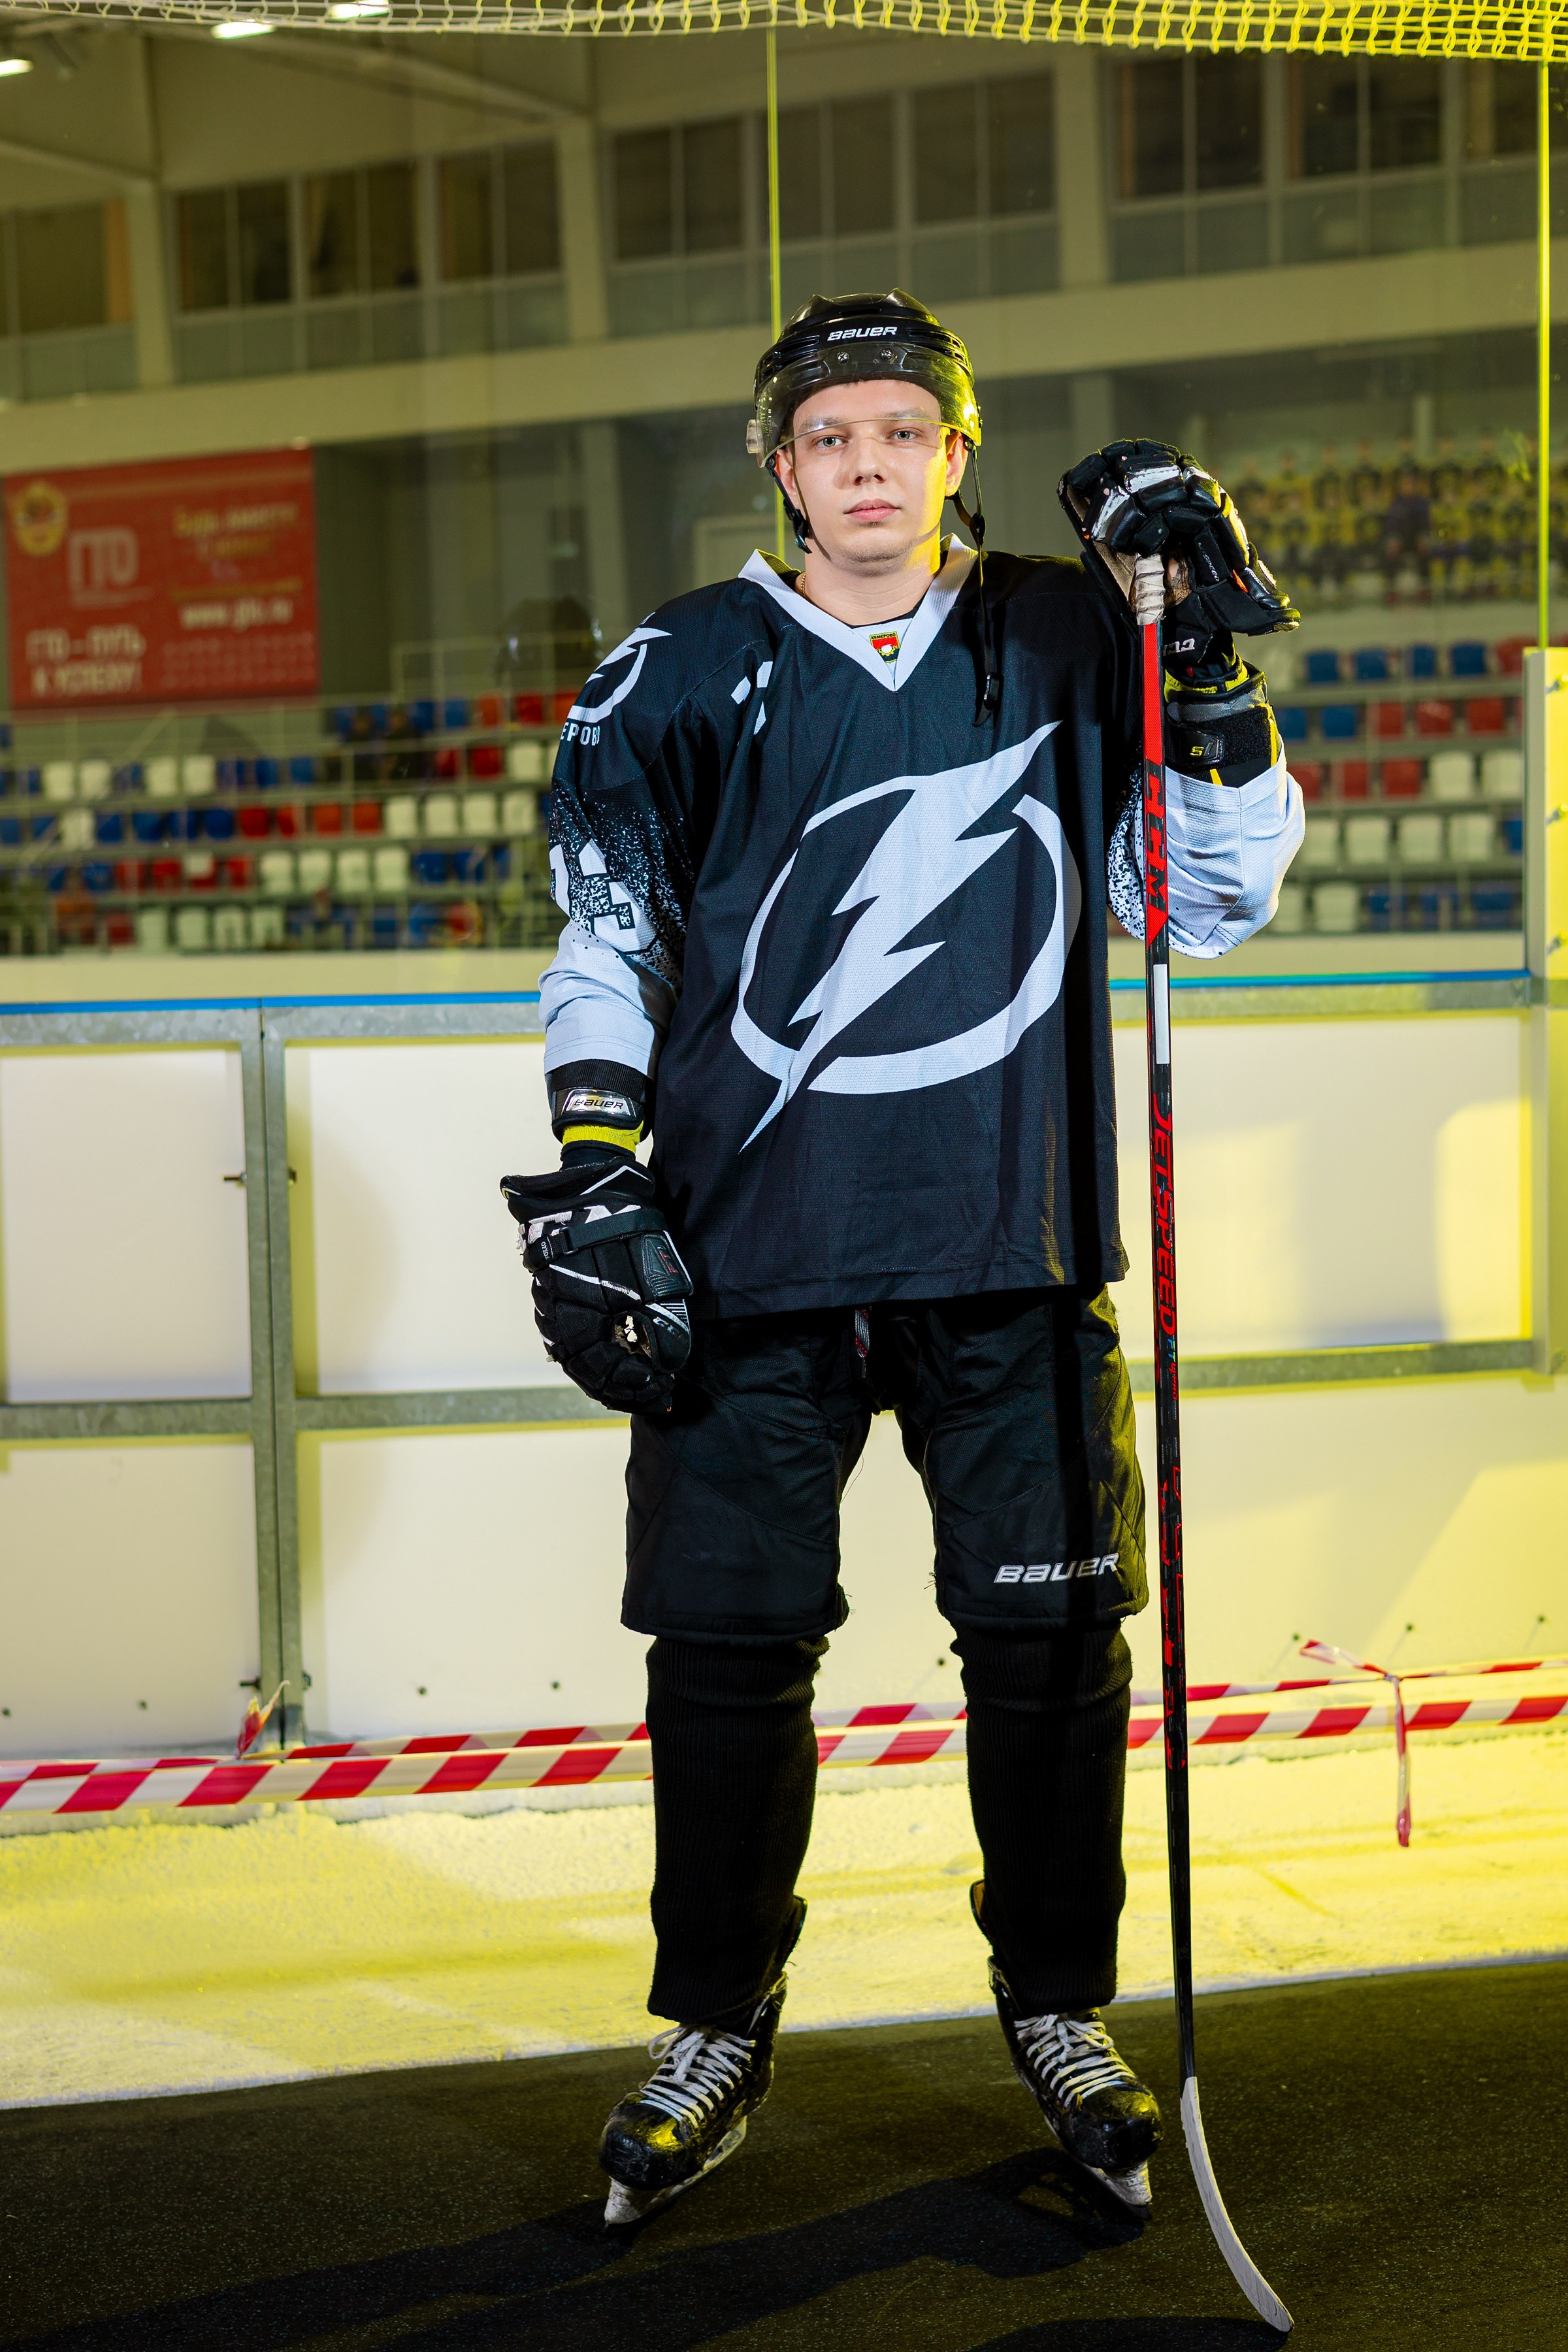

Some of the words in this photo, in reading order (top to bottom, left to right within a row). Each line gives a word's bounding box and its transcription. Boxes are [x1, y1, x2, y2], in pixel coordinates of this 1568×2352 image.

[827, 326, 898, 342] BAUER
[574, 1099, 624, 1109] BAUER
[1153, 1093, 1176, 1336] JETSPEED
[993, 1552, 1119, 1584] BAUER
